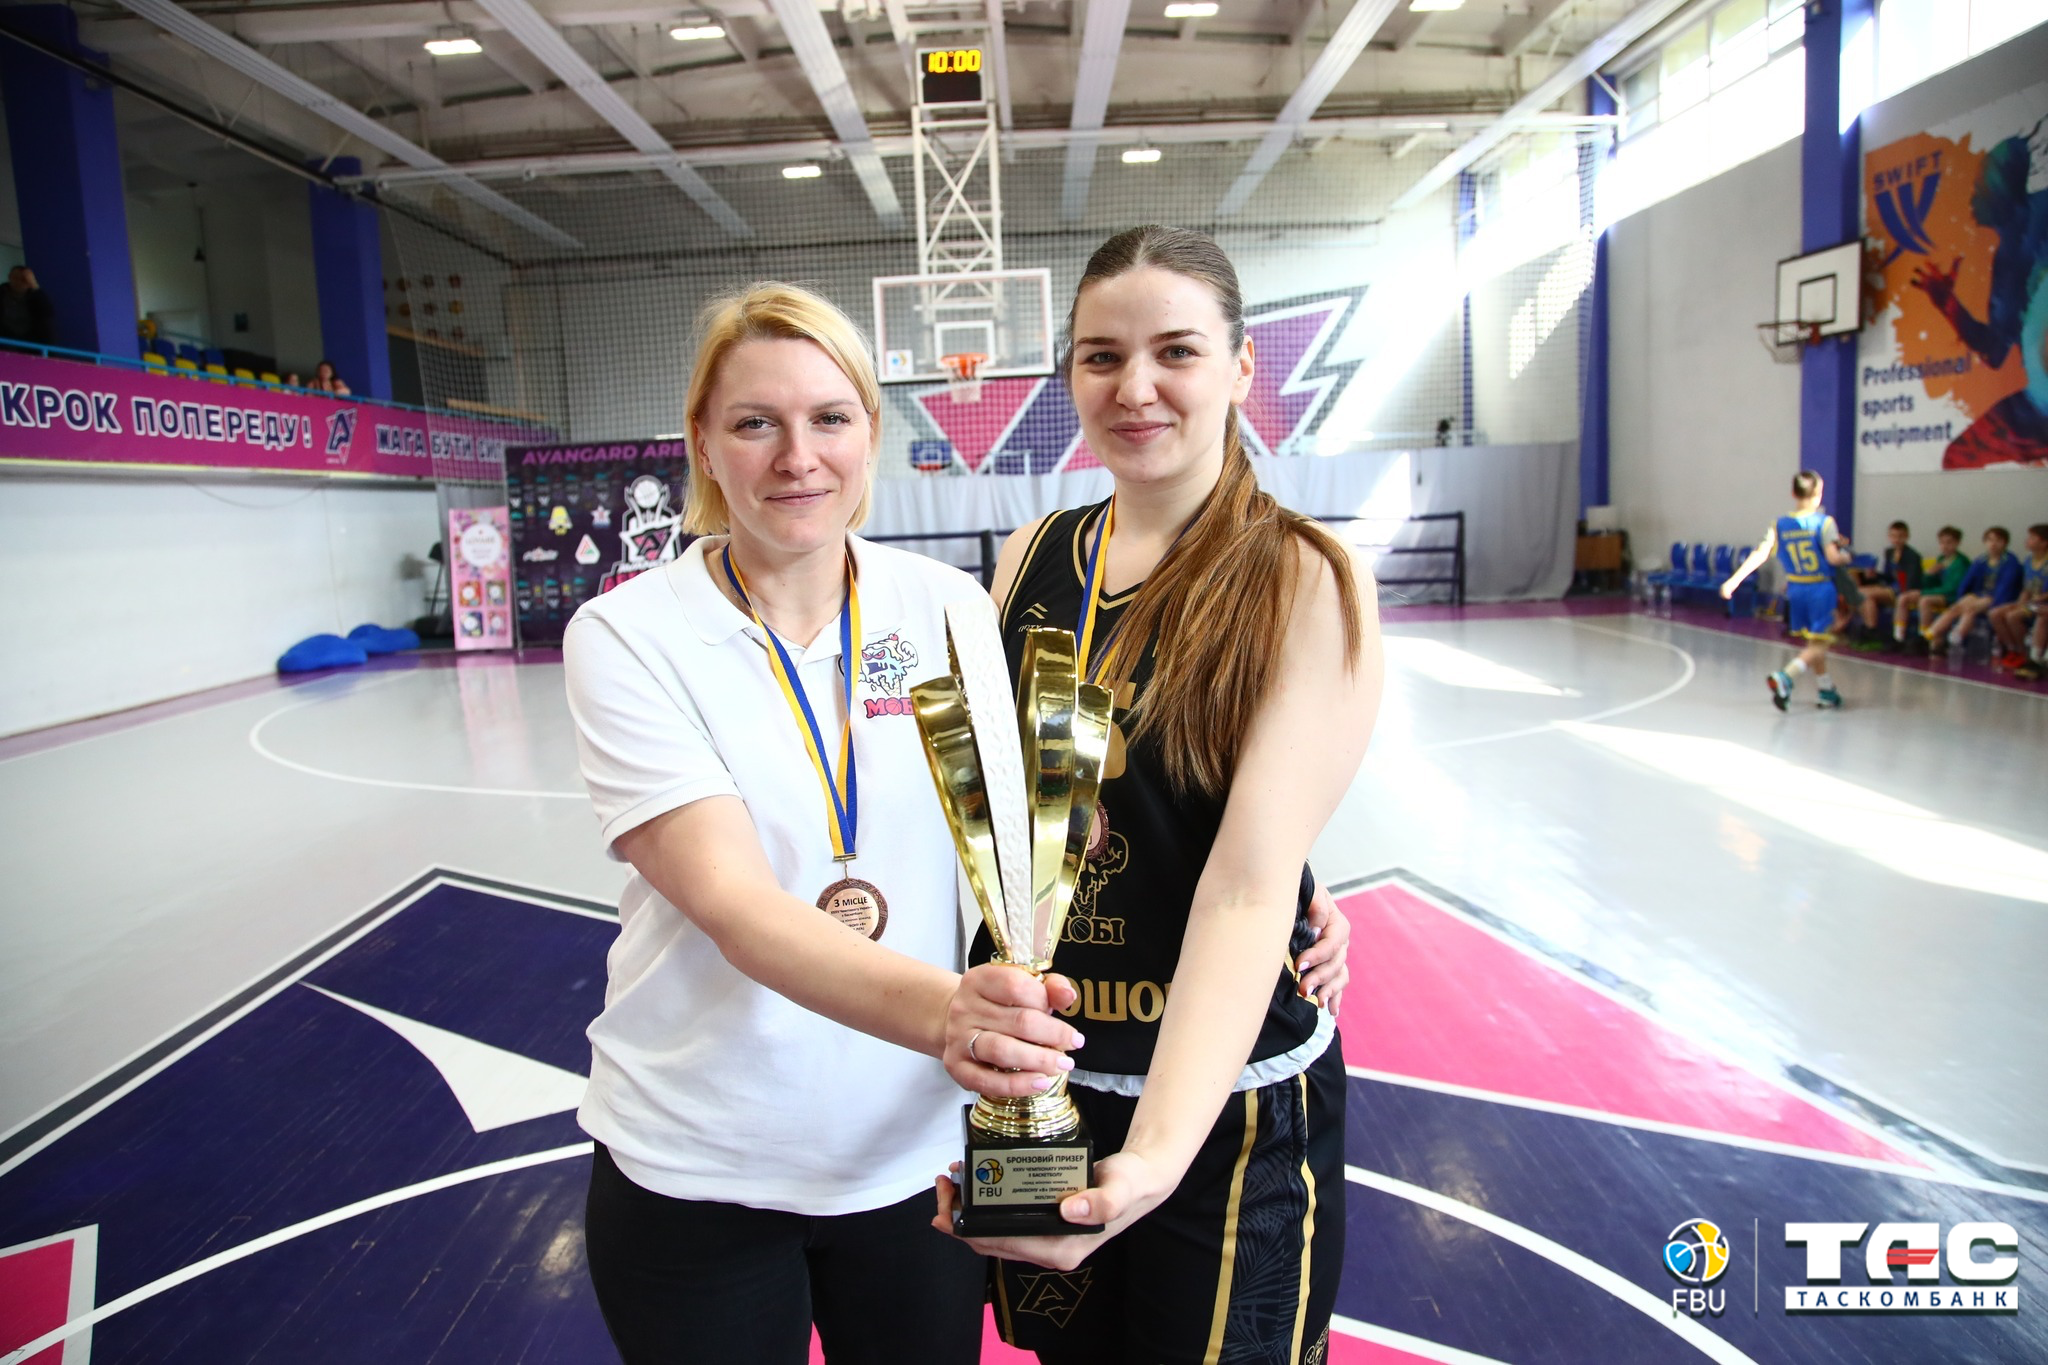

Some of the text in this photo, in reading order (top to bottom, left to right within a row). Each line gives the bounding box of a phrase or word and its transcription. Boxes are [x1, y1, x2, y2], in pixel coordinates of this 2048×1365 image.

[928, 49, 981, 73] 10:00
[1874, 151, 1943, 191] SWIFT
[1863, 354, 1972, 387] Professional
[0, 381, 122, 434] КРОК
[1862, 395, 1914, 419] sports
[375, 423, 428, 457] ЖАГА
[429, 431, 474, 461] БУТИ
[1861, 421, 1951, 449] equipment
[522, 441, 685, 465] AVANGARD ARE
[1786, 541, 1819, 574] 15
[834, 896, 867, 907] 3 МІСЦЕ
[1006, 1155, 1053, 1164] БРОНЗОВИЙ
[978, 1187, 1003, 1197] FBU
